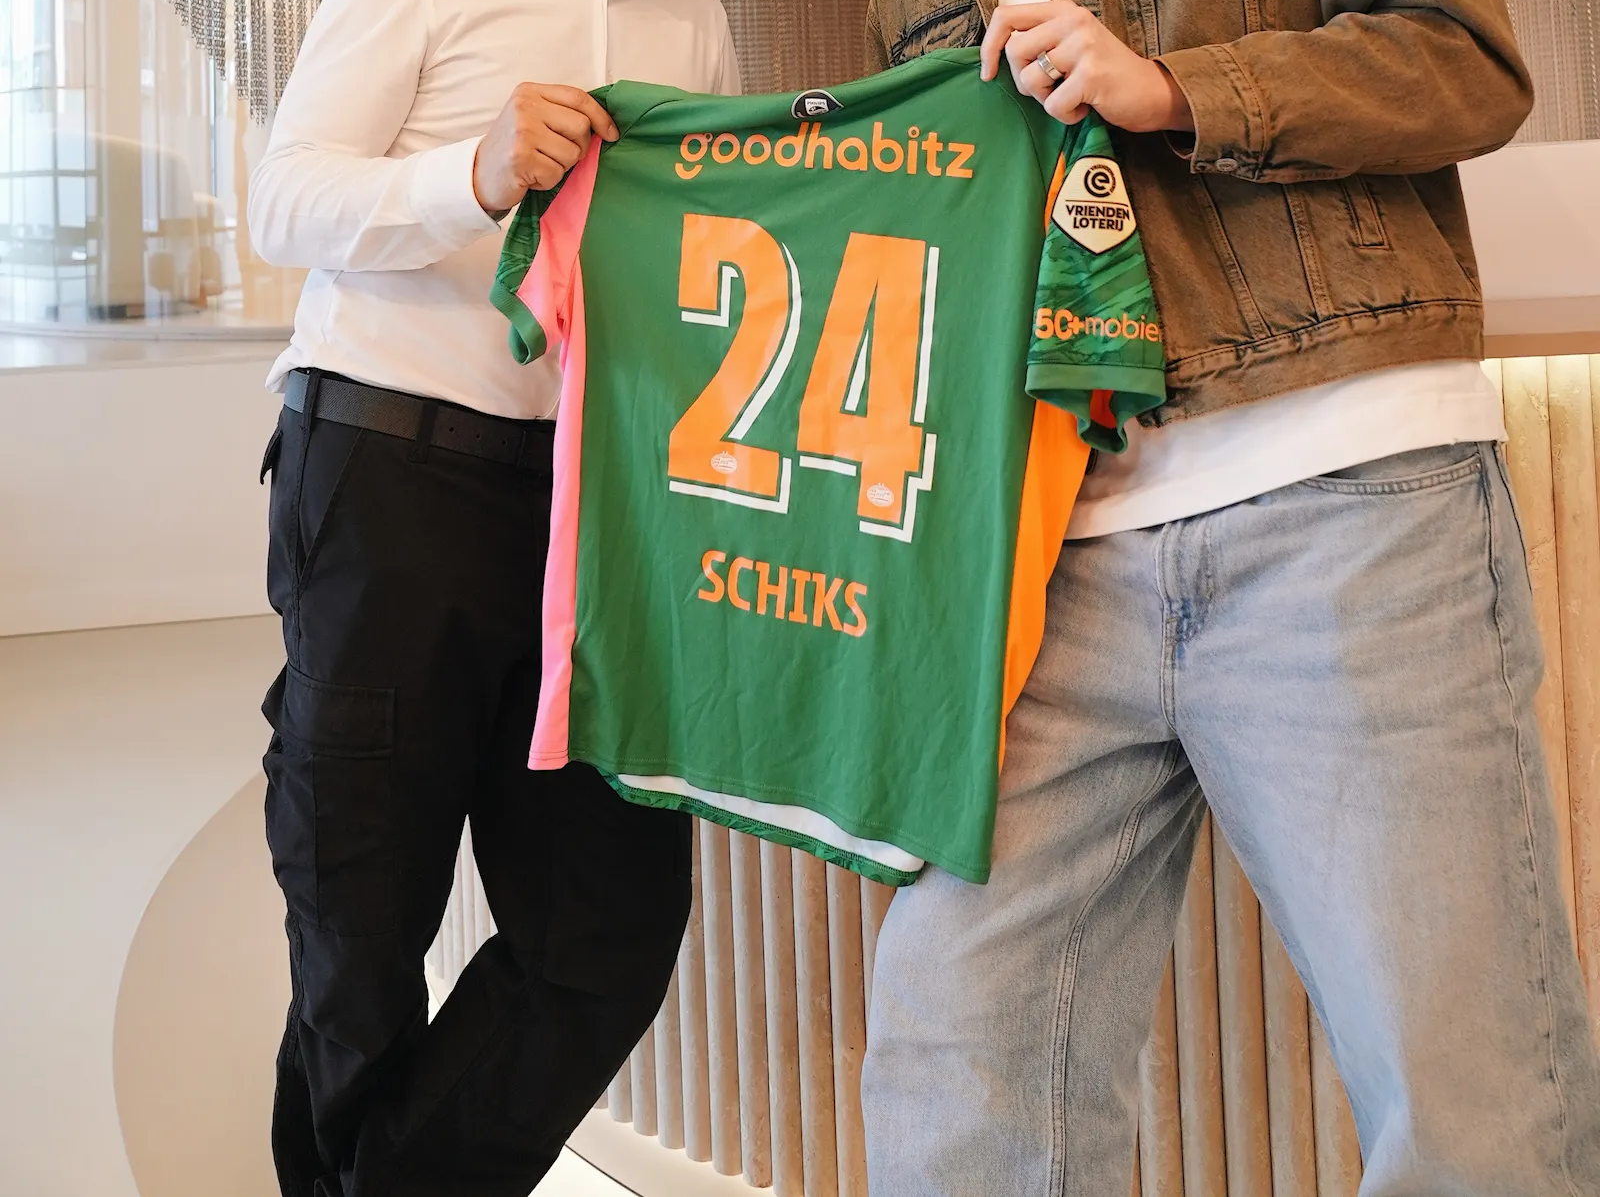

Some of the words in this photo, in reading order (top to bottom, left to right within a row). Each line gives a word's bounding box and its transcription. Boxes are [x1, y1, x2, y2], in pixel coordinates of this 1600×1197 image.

[675, 122, 976, 179] goodhabitz
[1065, 204, 1130, 220] VRIENDEN
[1073, 217, 1123, 231] LOTERIJ
[668, 213, 940, 543] 24
[698, 549, 868, 638] SCHIKS
